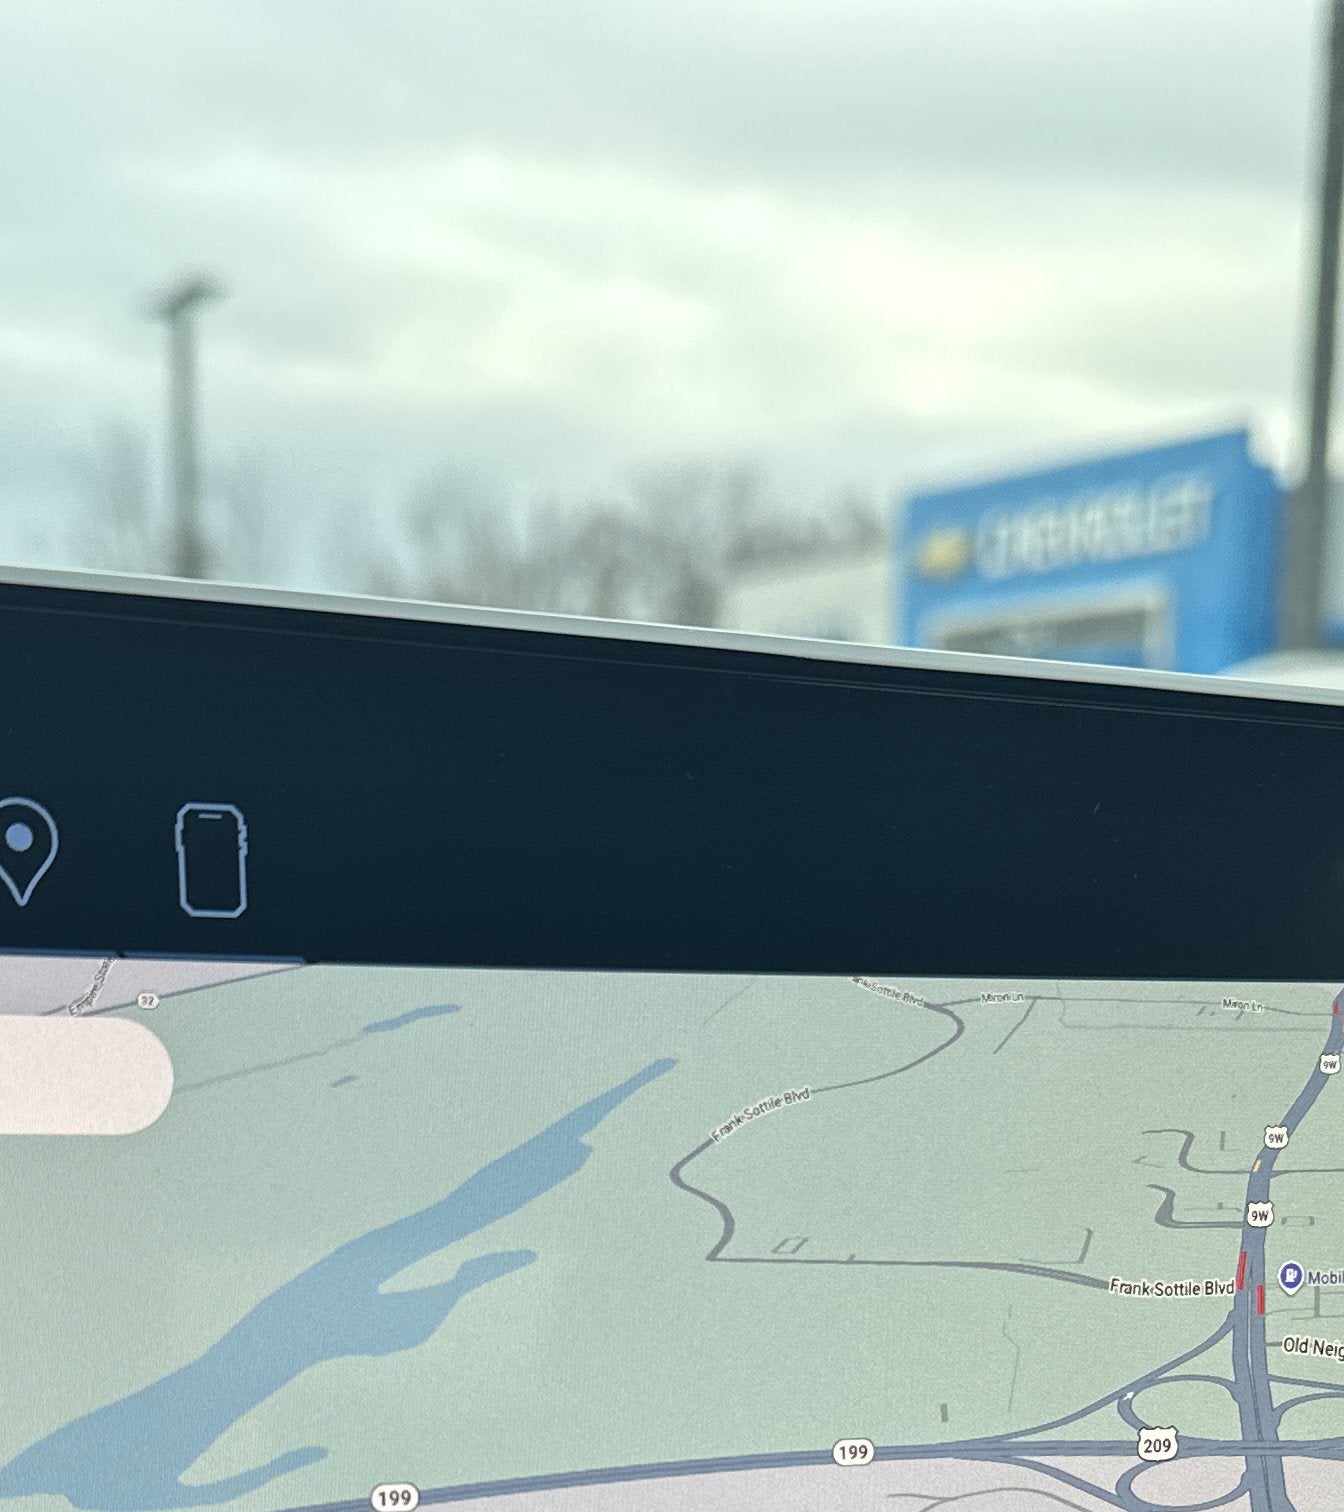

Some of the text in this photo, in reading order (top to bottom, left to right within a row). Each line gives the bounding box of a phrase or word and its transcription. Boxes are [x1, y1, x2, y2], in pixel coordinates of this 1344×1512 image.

[1322, 1060, 1338, 1070] 9W
[711, 1087, 810, 1142] Frank Sottile Blvd
[1268, 1132, 1285, 1144] 9W
[1250, 1209, 1270, 1222] 9W
[1109, 1277, 1235, 1297] Frank Sottile Blvd
[1283, 1336, 1309, 1354] Old
[838, 1444, 868, 1460] 199
[1143, 1437, 1172, 1454] 209
[378, 1489, 412, 1507] 199
